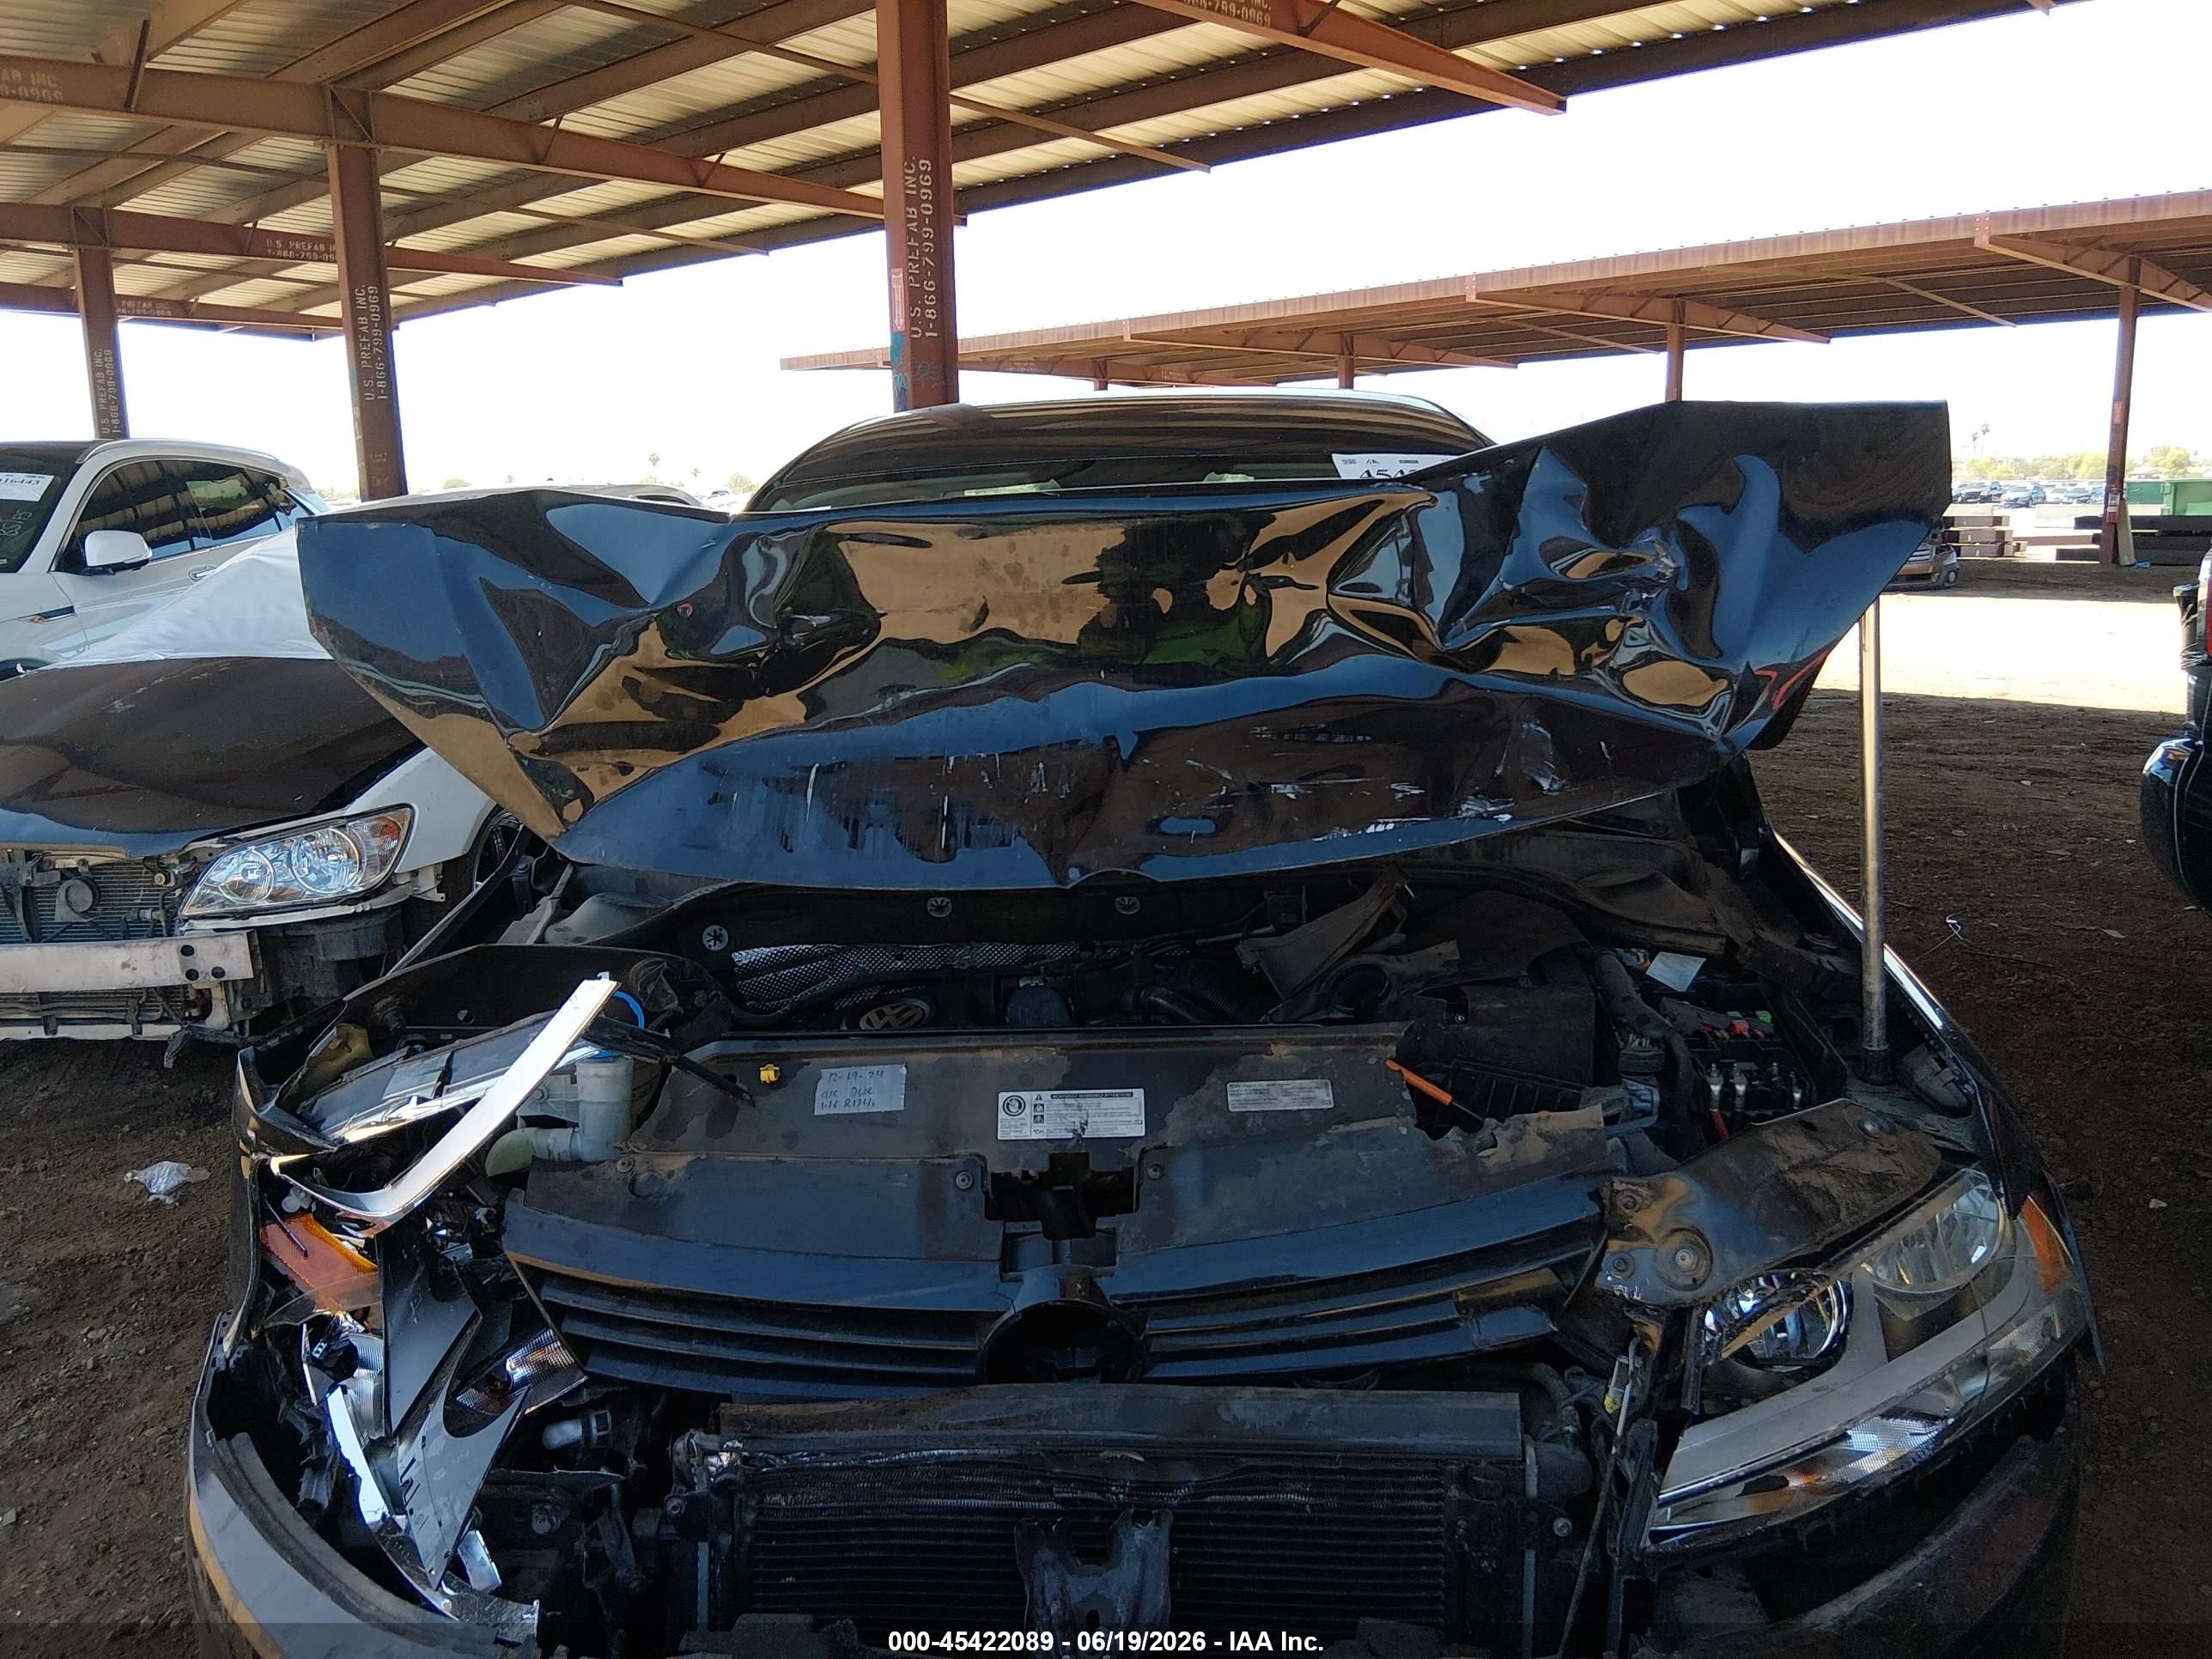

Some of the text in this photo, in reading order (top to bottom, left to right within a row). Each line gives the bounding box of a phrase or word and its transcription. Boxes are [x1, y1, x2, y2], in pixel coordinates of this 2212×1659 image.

[904, 156, 922, 338] U.S. PREFAB INC.
[919, 159, 938, 337] 1-866-799-0969
[355, 284, 368, 309] INC.
[357, 317, 372, 368] PREFAB
[368, 286, 388, 399] 1-866-799-0969
[96, 372, 107, 410] PREFAB
